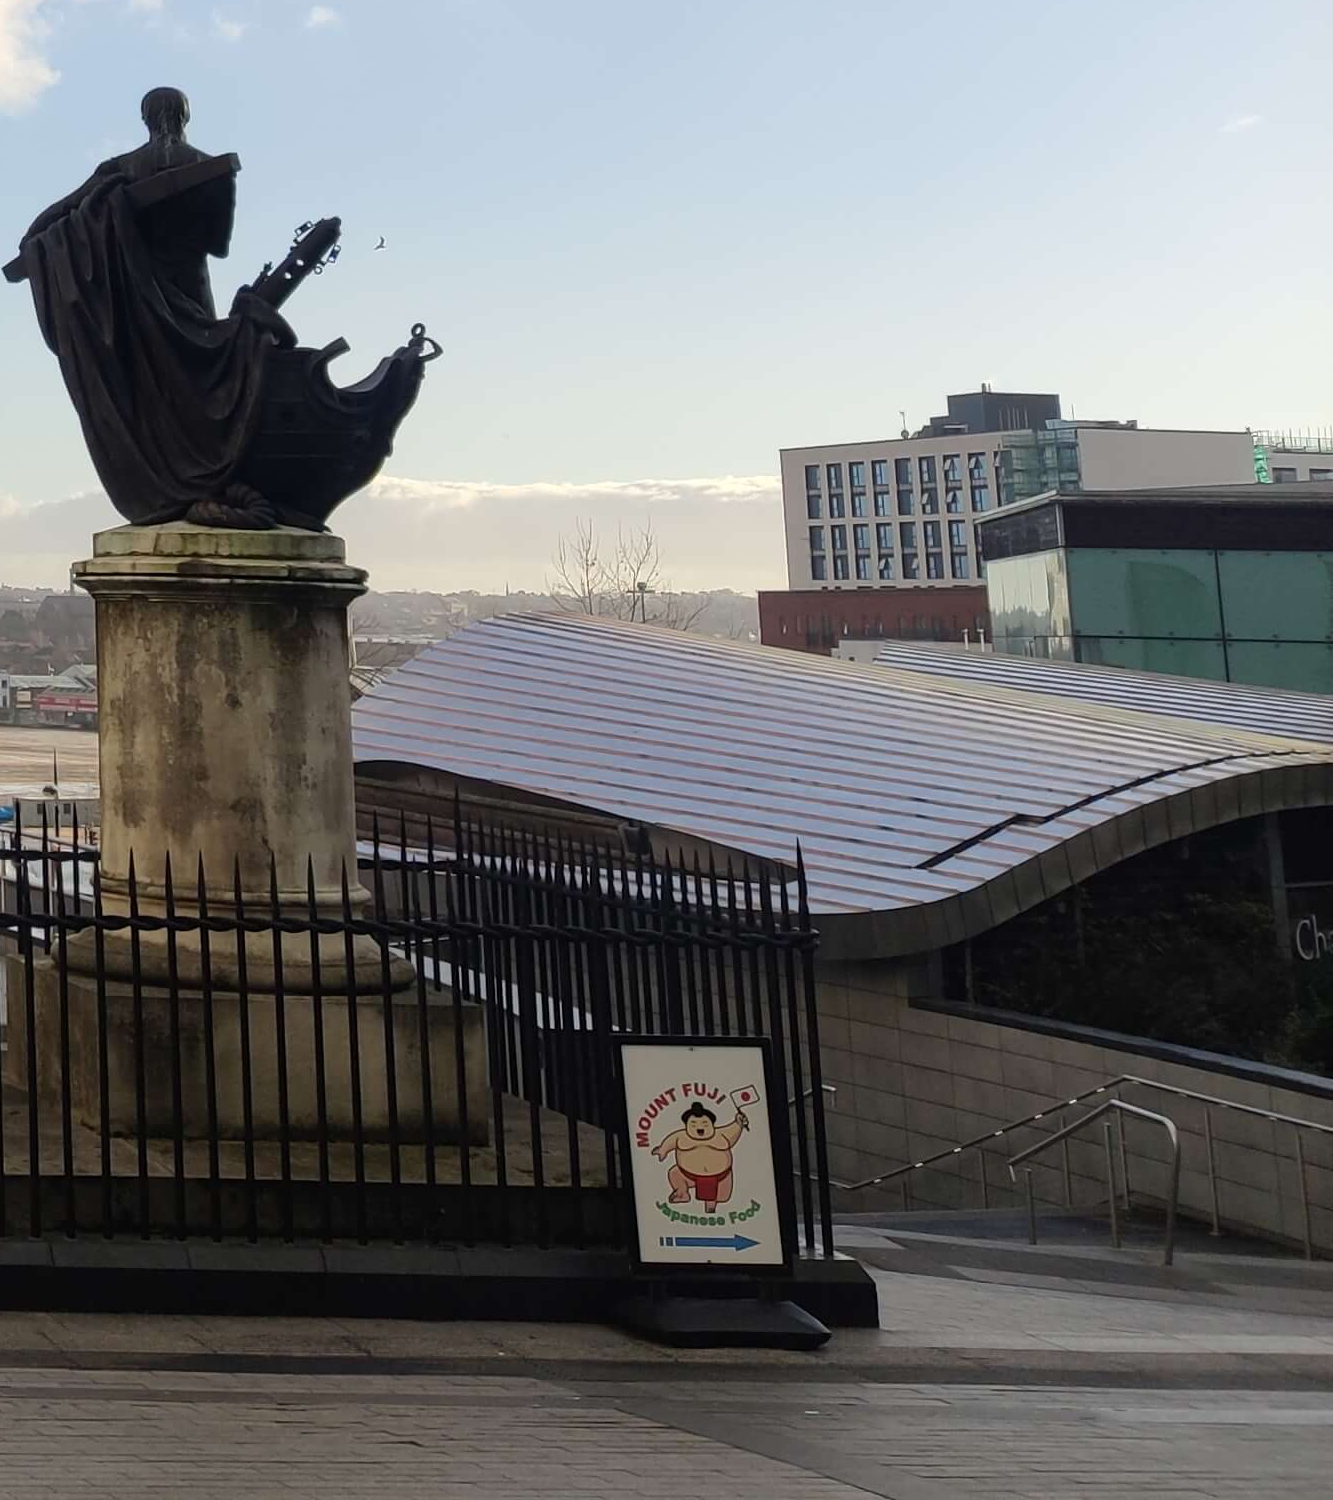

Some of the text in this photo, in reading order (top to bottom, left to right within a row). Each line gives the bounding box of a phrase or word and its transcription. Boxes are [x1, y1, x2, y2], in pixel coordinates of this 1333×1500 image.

[636, 1082, 726, 1148] MOUNT FUJI
[655, 1199, 761, 1227] Japanese Food
